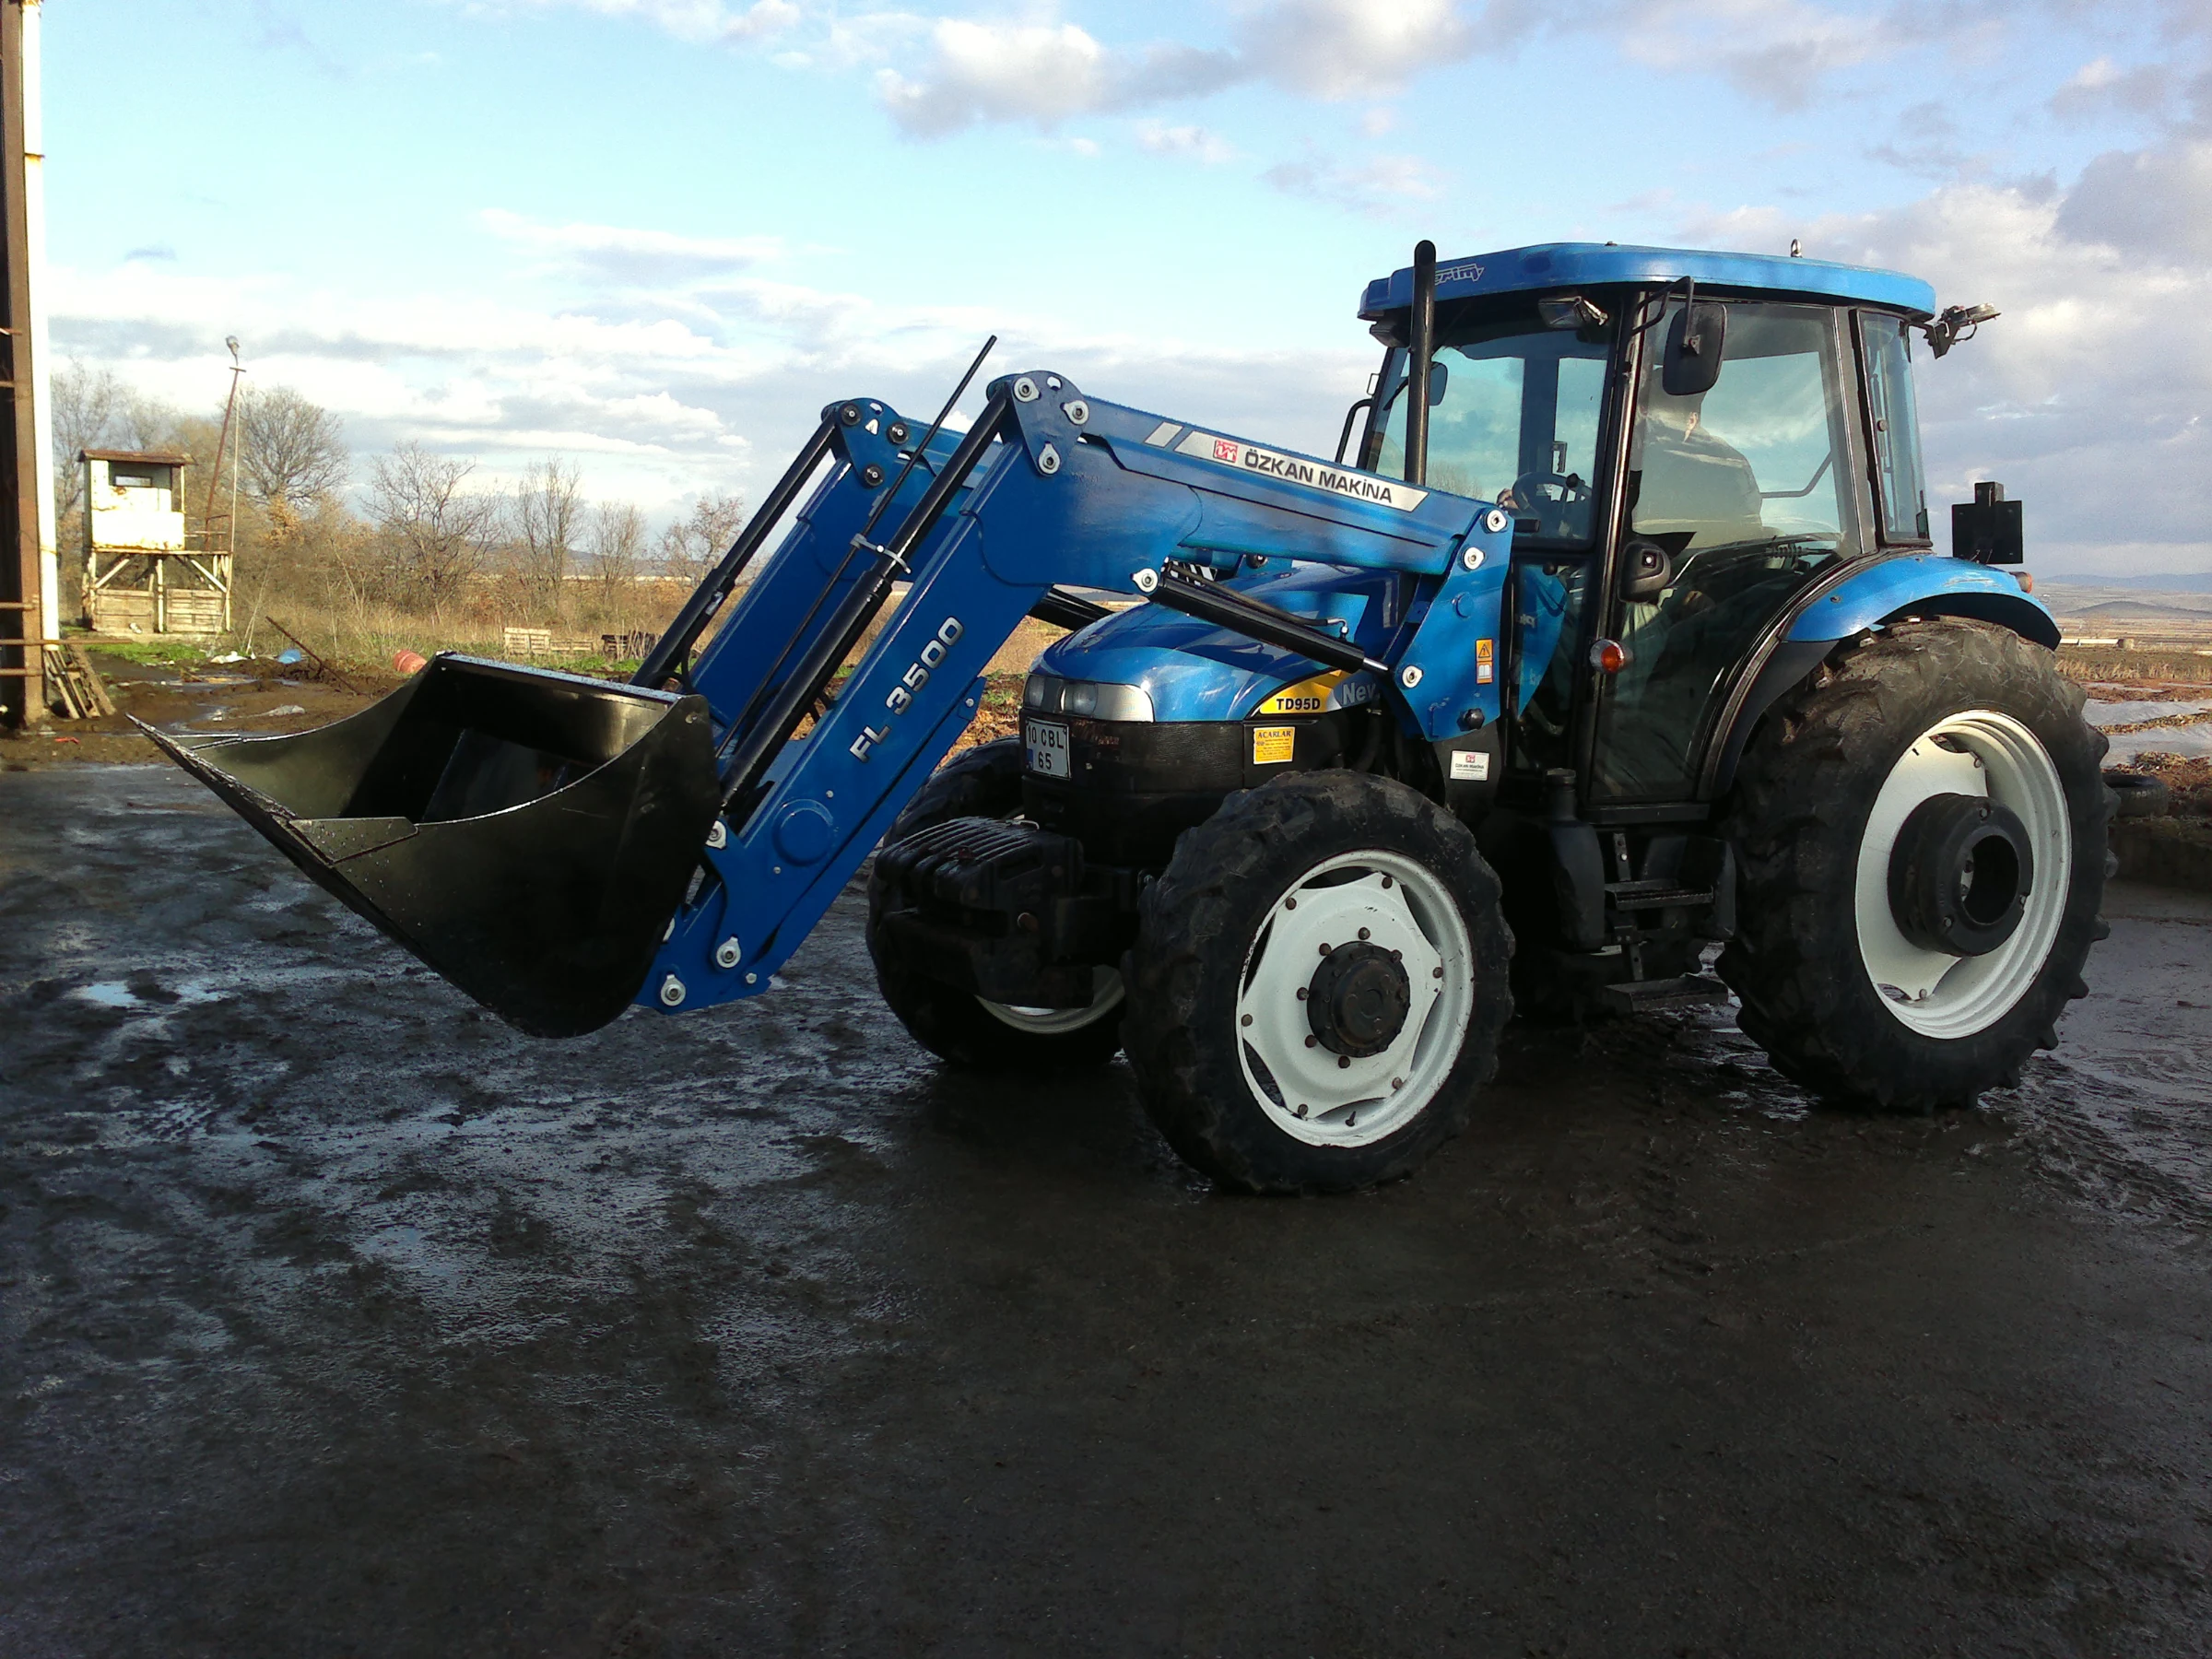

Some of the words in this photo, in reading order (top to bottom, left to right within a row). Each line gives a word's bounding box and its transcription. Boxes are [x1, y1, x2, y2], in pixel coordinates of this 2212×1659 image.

[1244, 448, 1313, 483] ÖZKAN
[1319, 471, 1393, 503] MAKİNA
[850, 725, 891, 763] FL
[886, 616, 964, 715] 3500
[1276, 698, 1321, 711] TD95D
[1028, 725, 1037, 744] 10
[1041, 728, 1065, 748] CBL
[1039, 751, 1053, 771] 65
